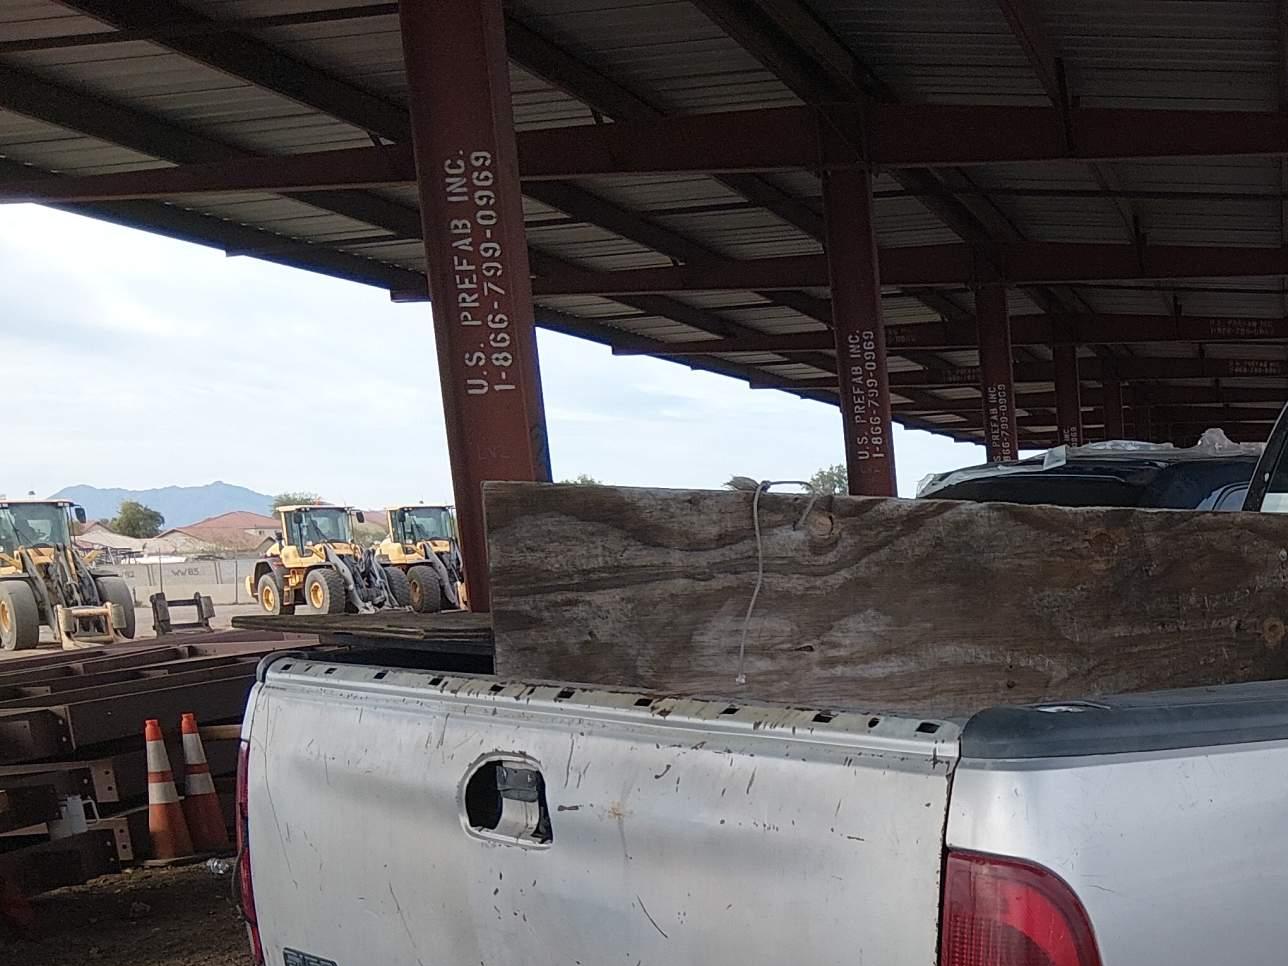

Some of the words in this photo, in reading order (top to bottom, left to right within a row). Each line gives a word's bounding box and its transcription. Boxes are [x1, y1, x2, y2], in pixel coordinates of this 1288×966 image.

[443, 149, 469, 203] INC.
[449, 218, 483, 327] PREFAB
[469, 150, 517, 392] 1-866-799-0969
[464, 343, 490, 395] U.S.
[847, 328, 862, 359] INC.
[849, 365, 868, 425] PREFAB
[862, 329, 885, 459] 1-866-799-0969
